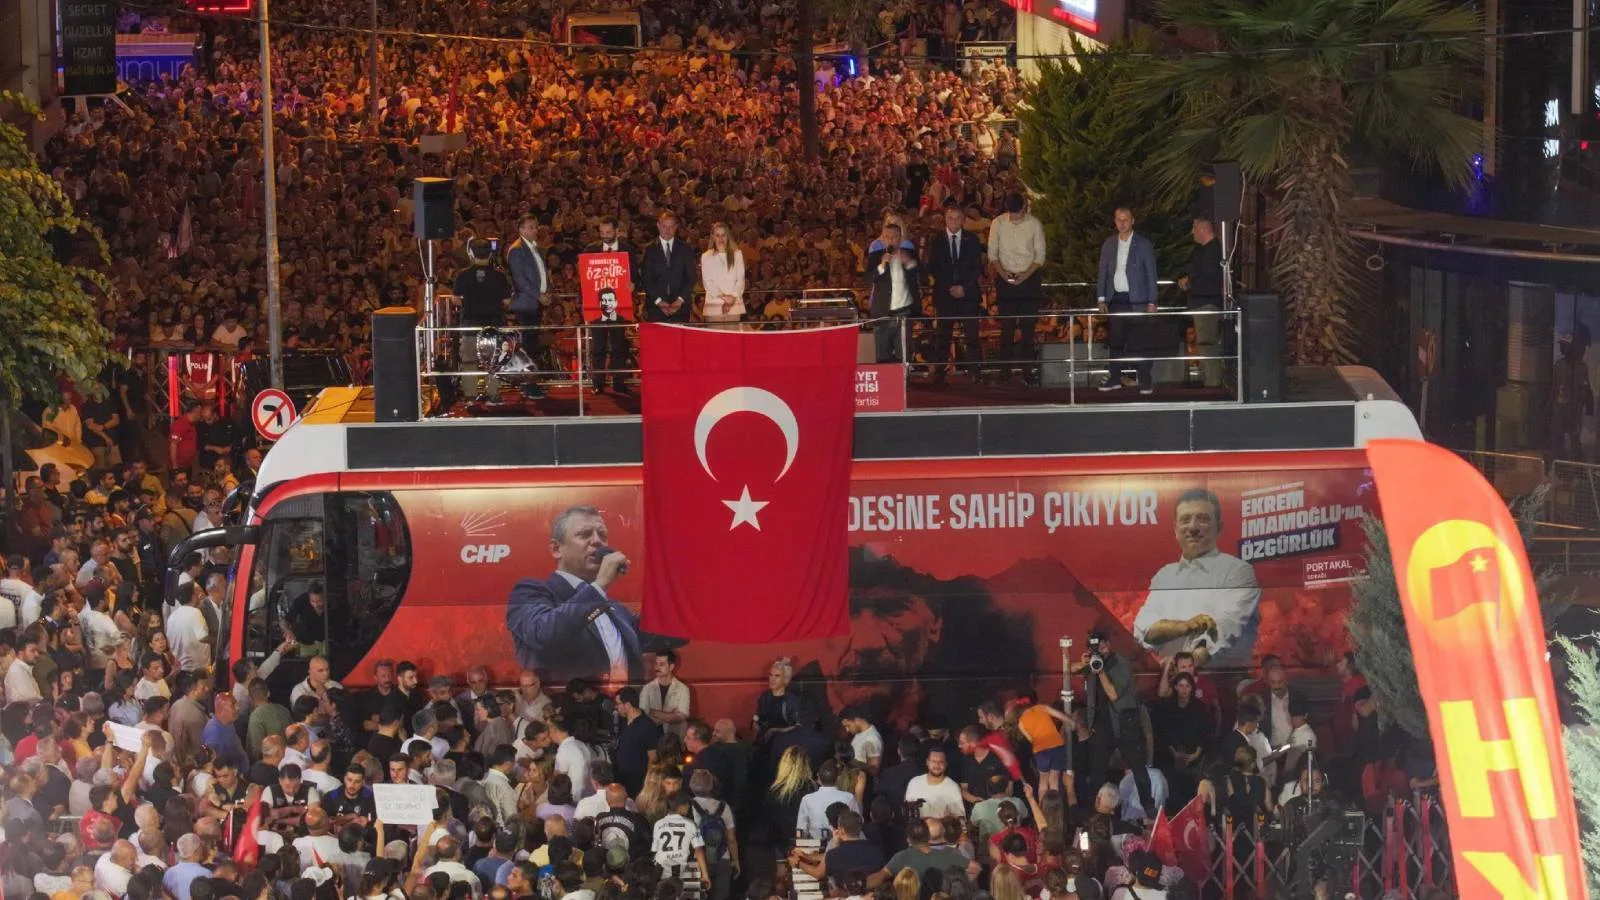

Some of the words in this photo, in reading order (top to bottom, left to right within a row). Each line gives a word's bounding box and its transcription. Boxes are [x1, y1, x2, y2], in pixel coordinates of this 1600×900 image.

[67, 3, 107, 17] SECRET
[1044, 490, 1159, 534] ÇIKIYOR
[1241, 490, 1305, 518] EKREM
[460, 544, 511, 564] CHP
[1241, 528, 1336, 562] ÖZGÜRLÜK
[1306, 559, 1353, 573] PORTAKAL
[659, 831, 686, 852] 27
